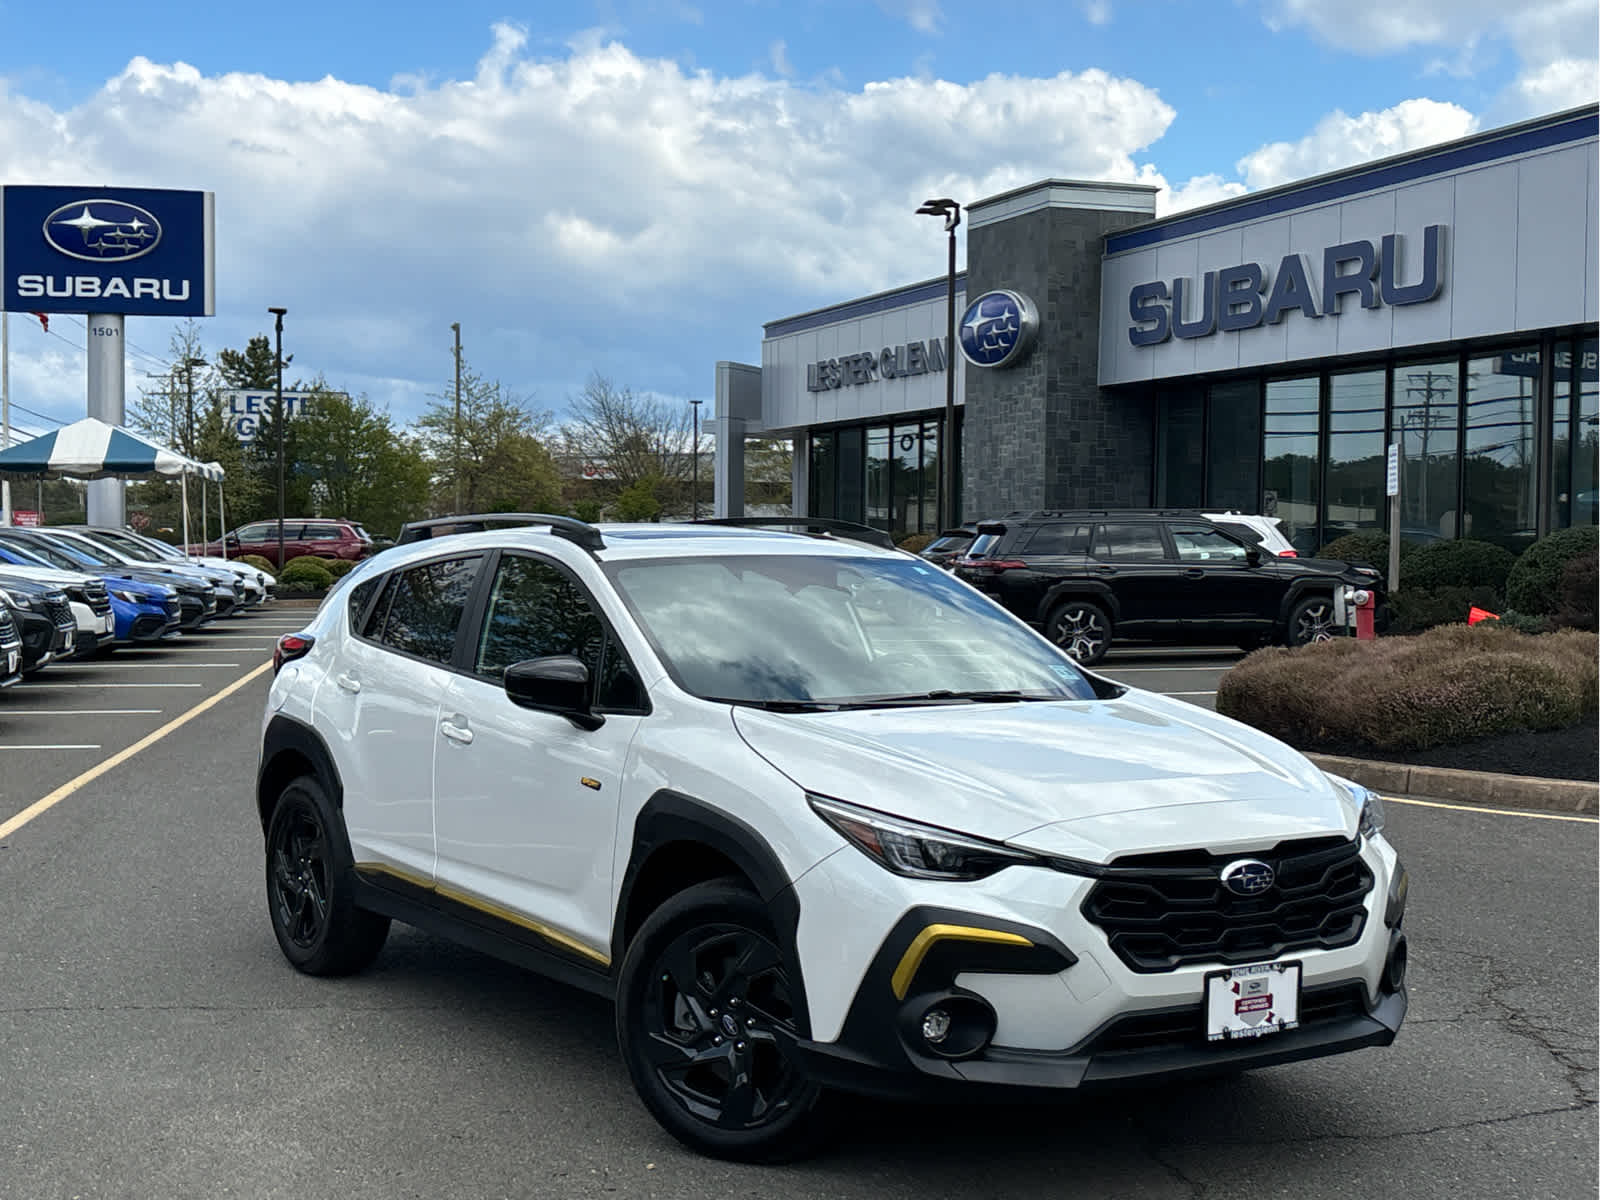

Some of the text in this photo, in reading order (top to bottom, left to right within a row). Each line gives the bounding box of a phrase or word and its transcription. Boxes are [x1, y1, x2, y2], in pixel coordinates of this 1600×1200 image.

[17, 275, 189, 300] SUBARU
[1128, 224, 1446, 347] SUBARU
[92, 327, 119, 337] 1501
[807, 351, 878, 392] LESTER
[229, 394, 312, 416] LESTE
